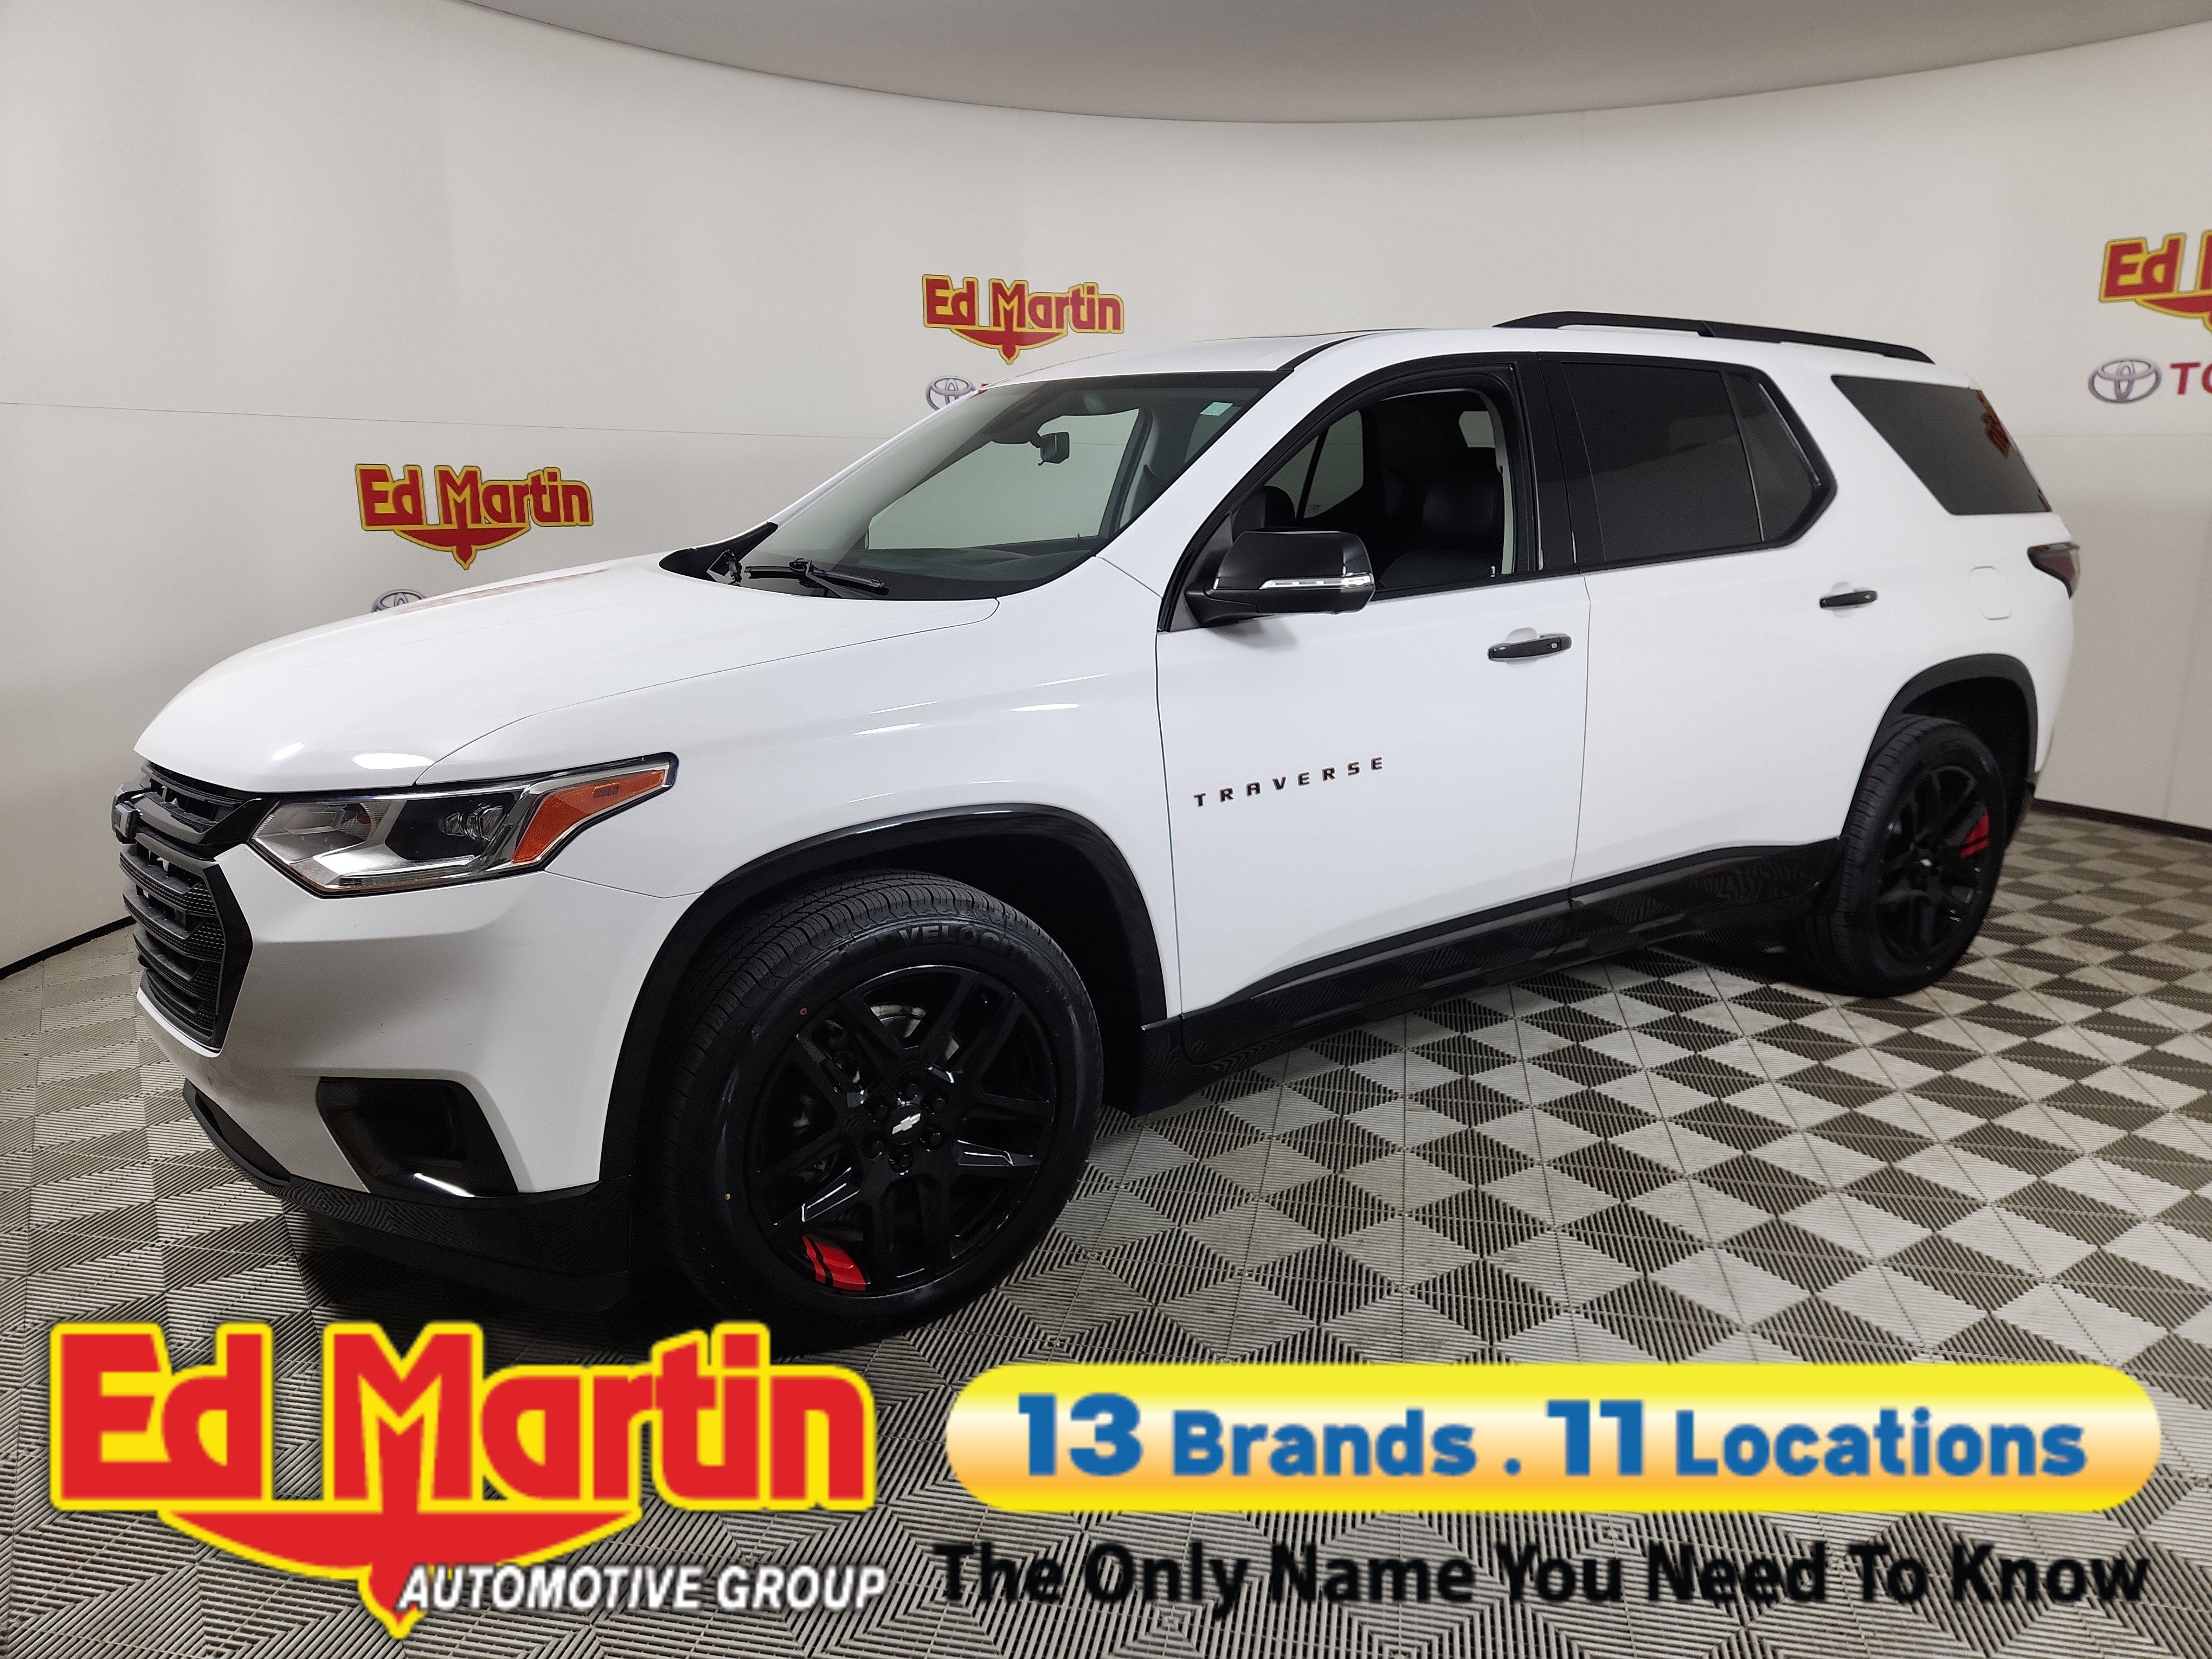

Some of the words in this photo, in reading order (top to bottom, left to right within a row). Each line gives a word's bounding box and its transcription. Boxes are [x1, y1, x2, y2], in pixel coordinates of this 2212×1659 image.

[2101, 235, 2184, 301] Ed
[924, 276, 977, 326] Ed
[990, 279, 1122, 332] Martin
[357, 466, 425, 528] Ed
[435, 466, 592, 525] Martin
[1193, 757, 1382, 807] TRAVERSE
